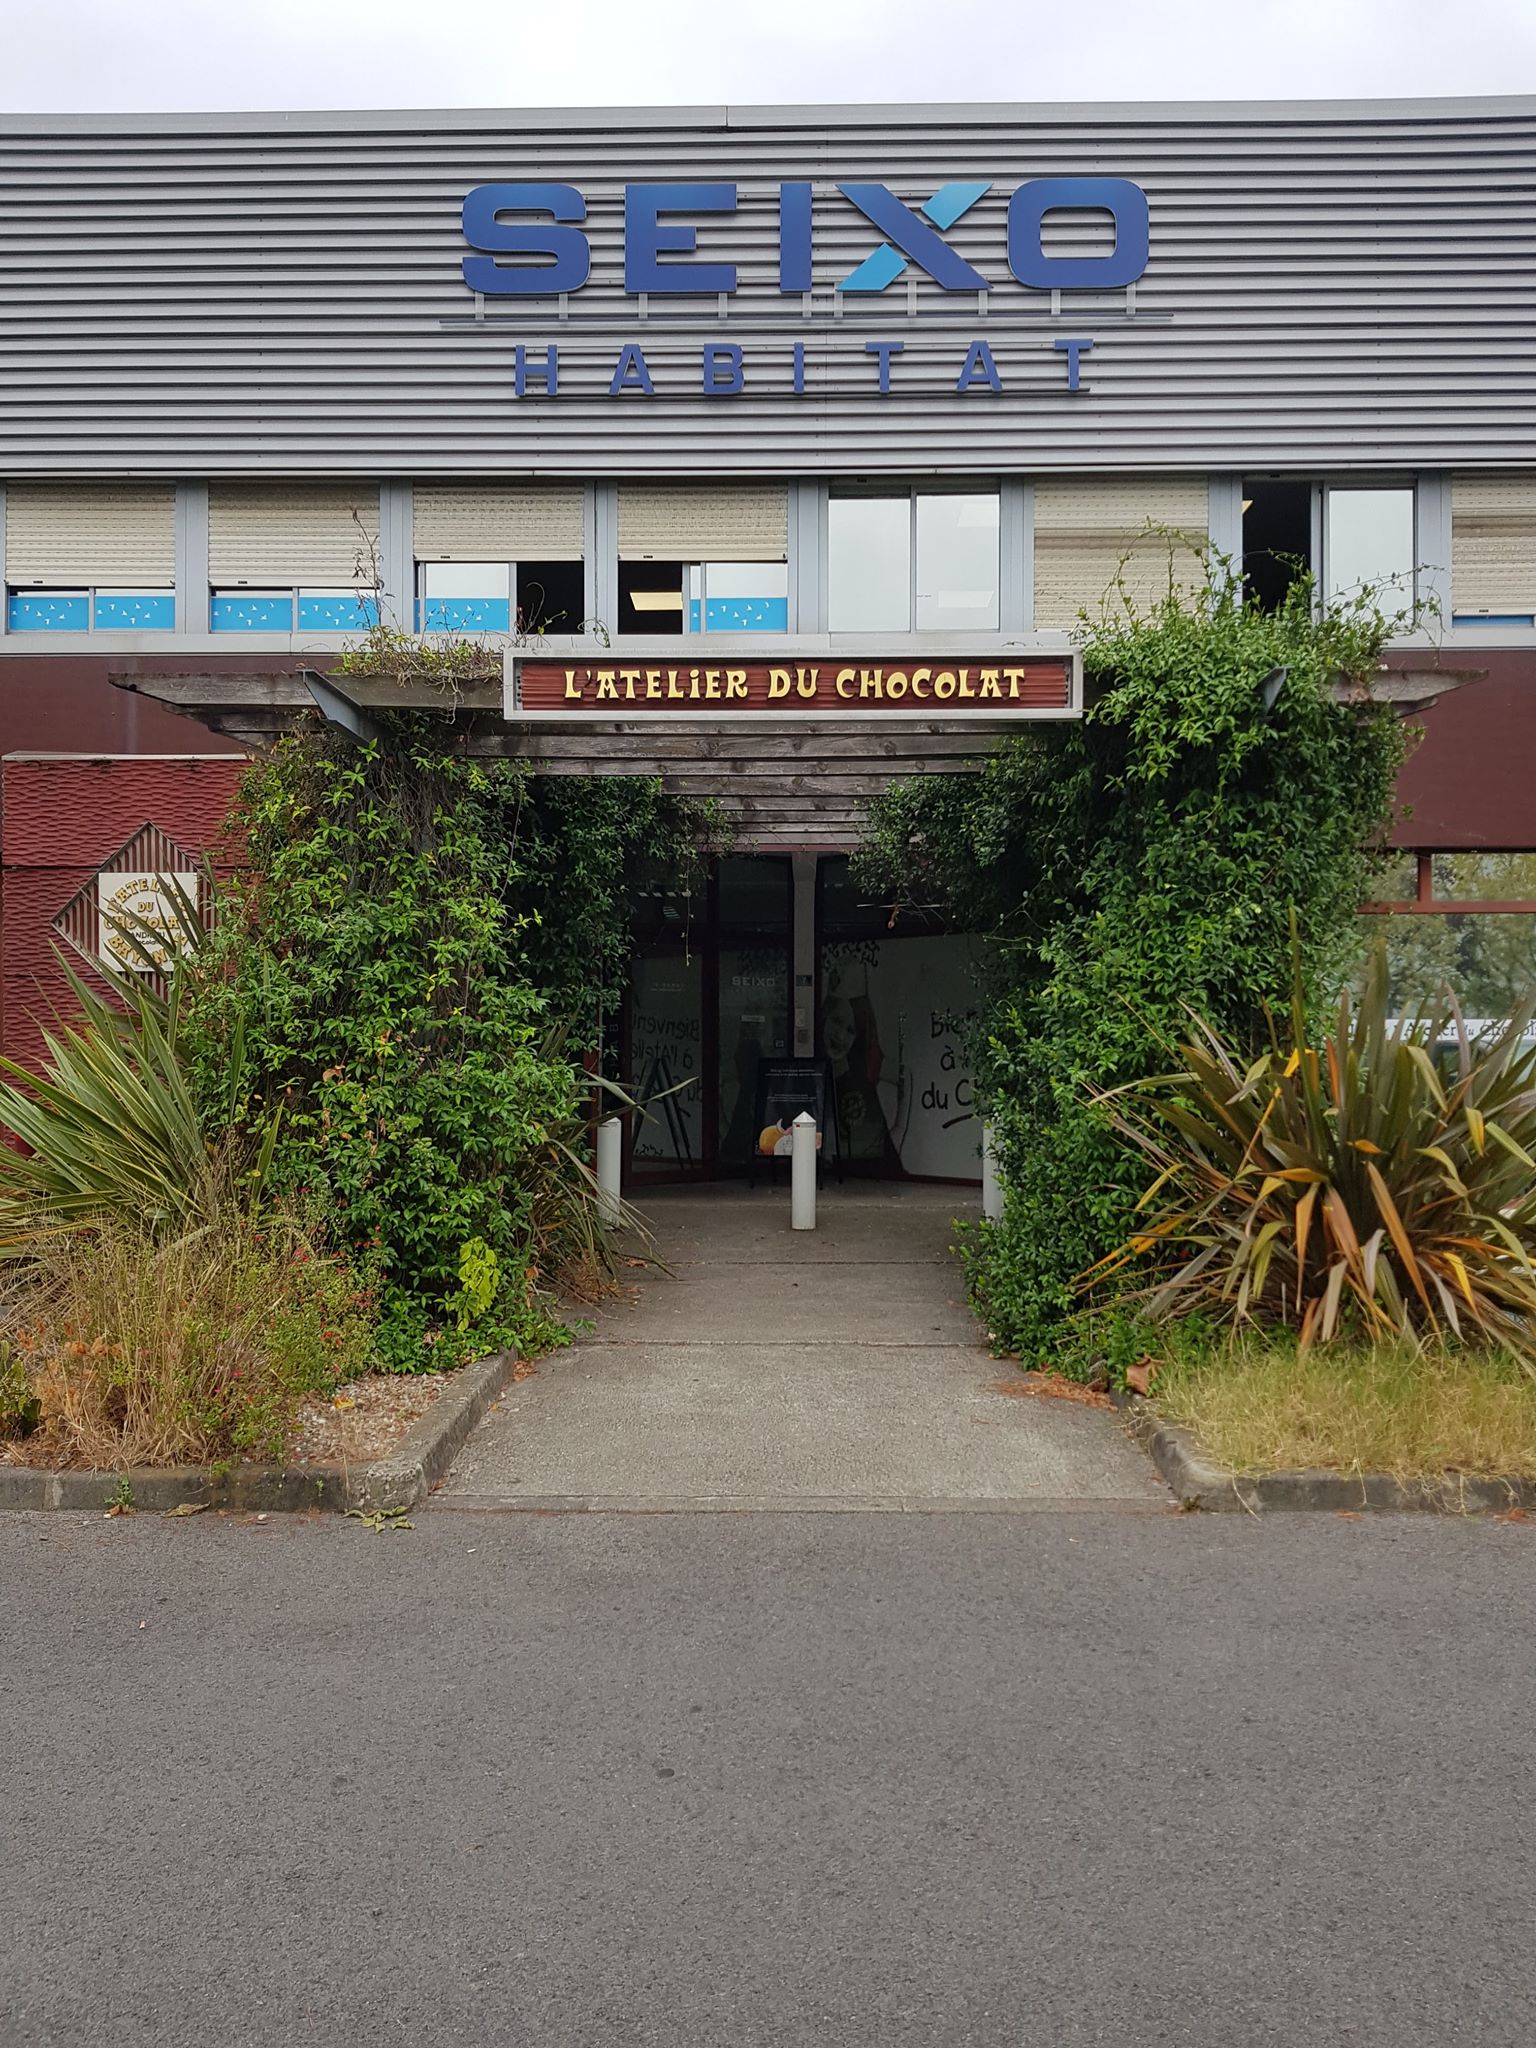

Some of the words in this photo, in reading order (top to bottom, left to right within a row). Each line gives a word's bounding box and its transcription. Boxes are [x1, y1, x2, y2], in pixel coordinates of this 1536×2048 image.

[461, 177, 1150, 295] SEIXO
[514, 338, 1094, 397] HABITAT
[768, 668, 819, 698] DU
[836, 668, 1025, 699] CHOCOLAT
[138, 902, 154, 912] DU
[732, 976, 775, 987] SEIXO
[922, 1082, 948, 1110] du
